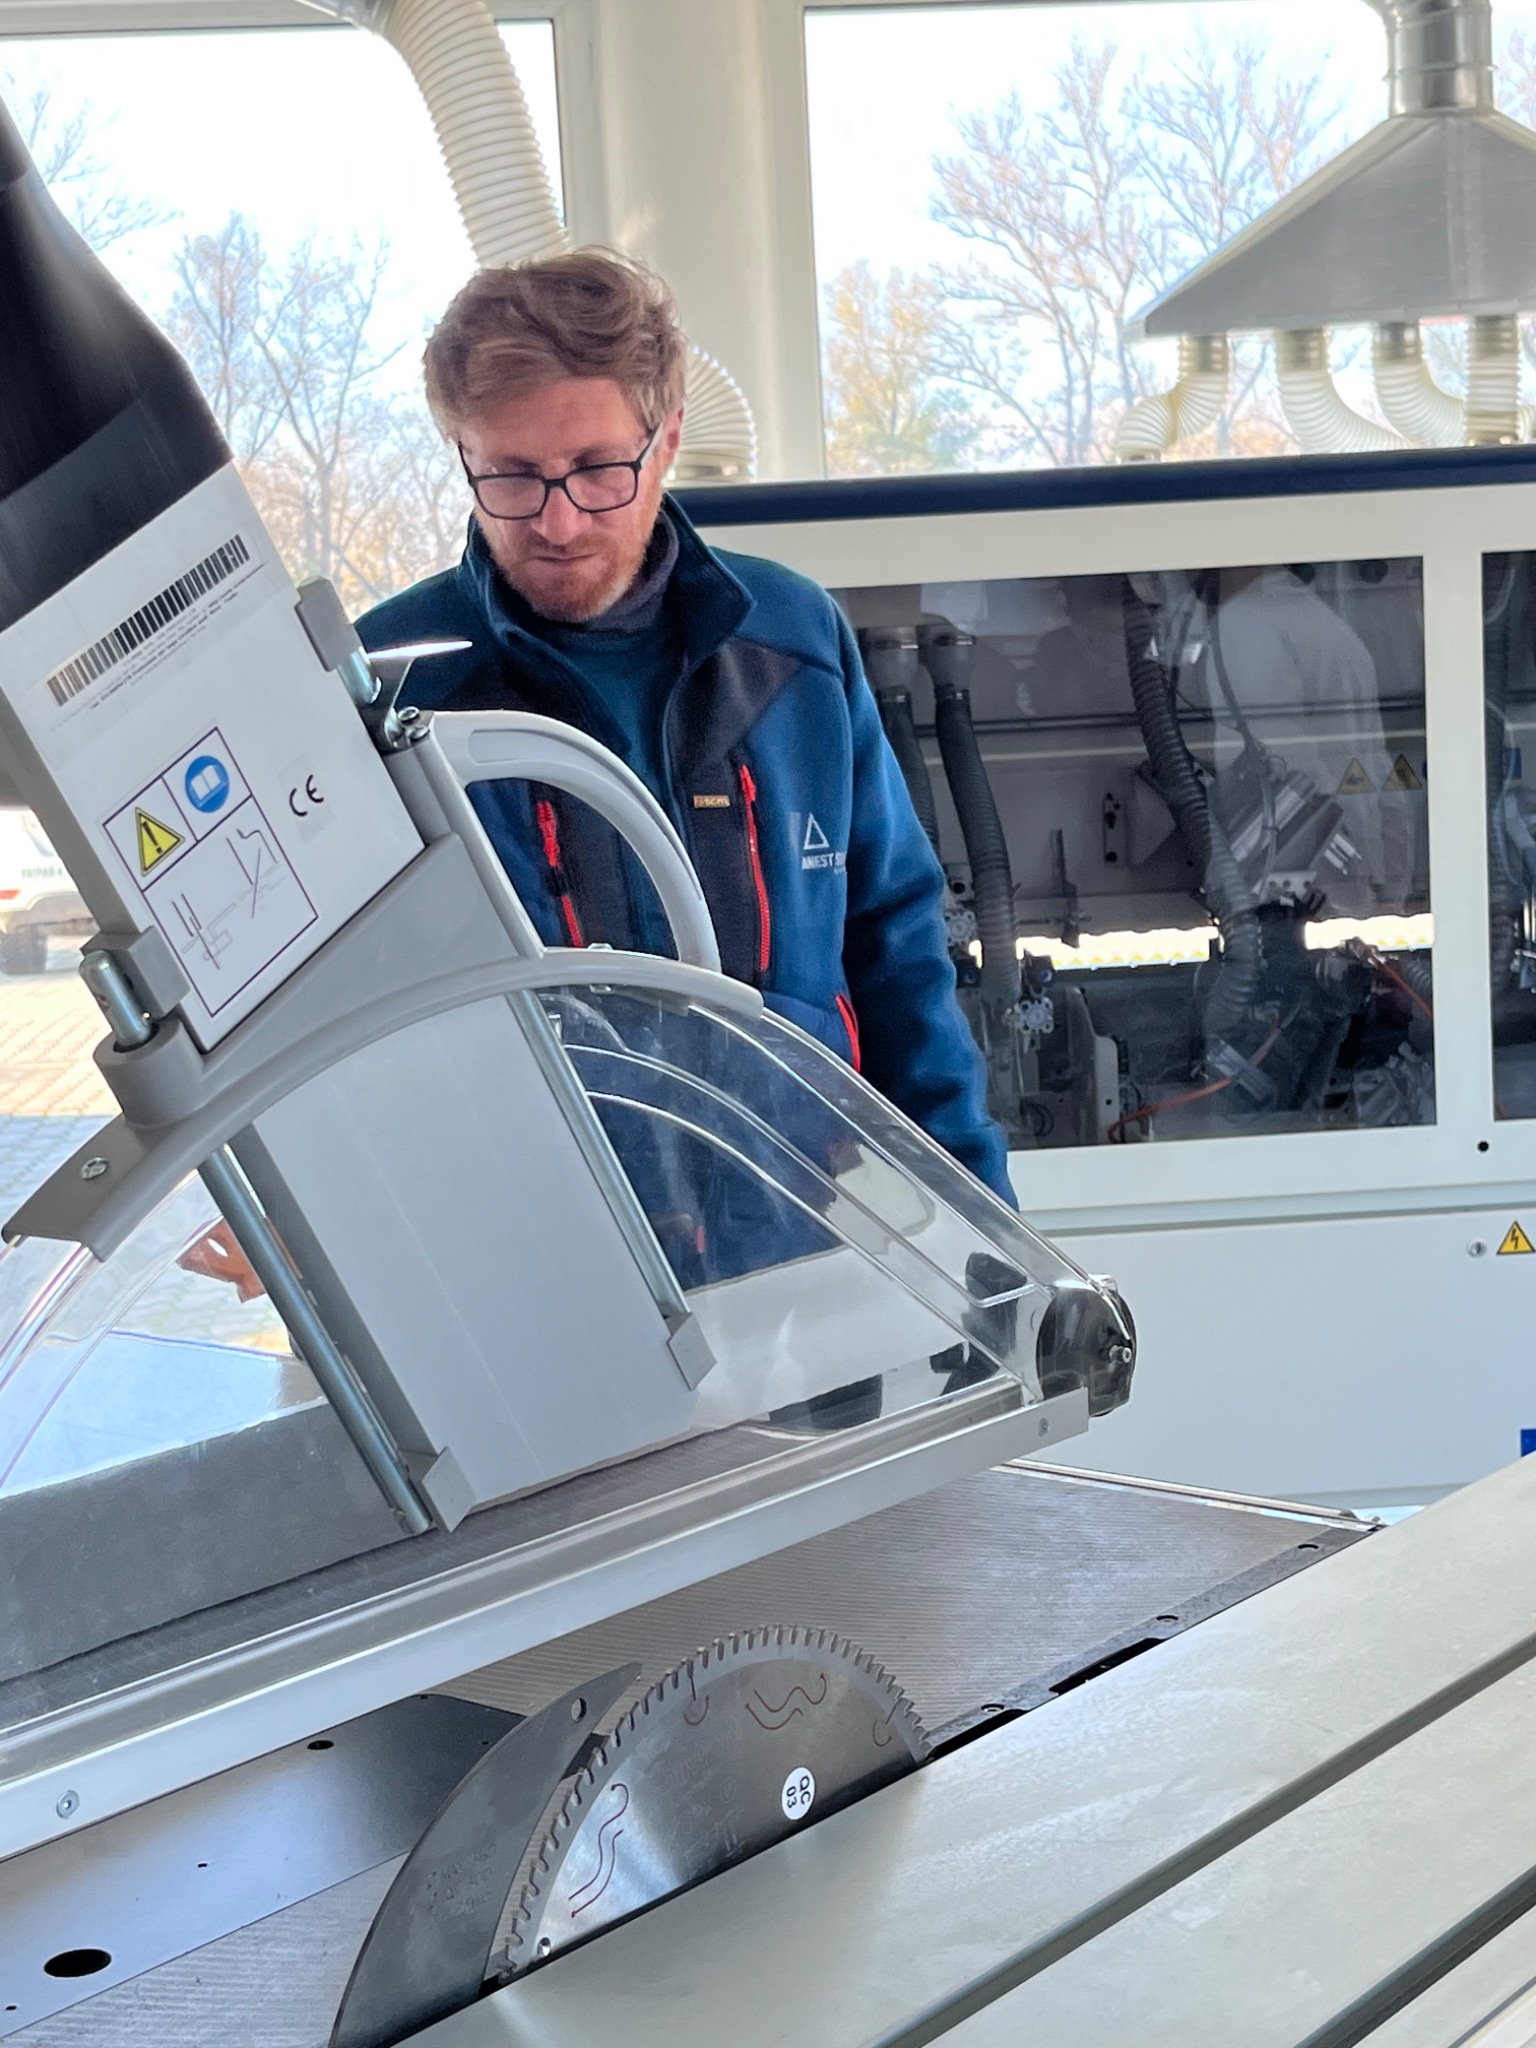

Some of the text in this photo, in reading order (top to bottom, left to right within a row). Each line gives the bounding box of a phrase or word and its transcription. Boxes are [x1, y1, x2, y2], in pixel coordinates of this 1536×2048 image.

[289, 774, 324, 817] CE
[801, 852, 834, 870] ANEST
[786, 1785, 797, 1809] 03
[799, 1775, 811, 1805] QC
